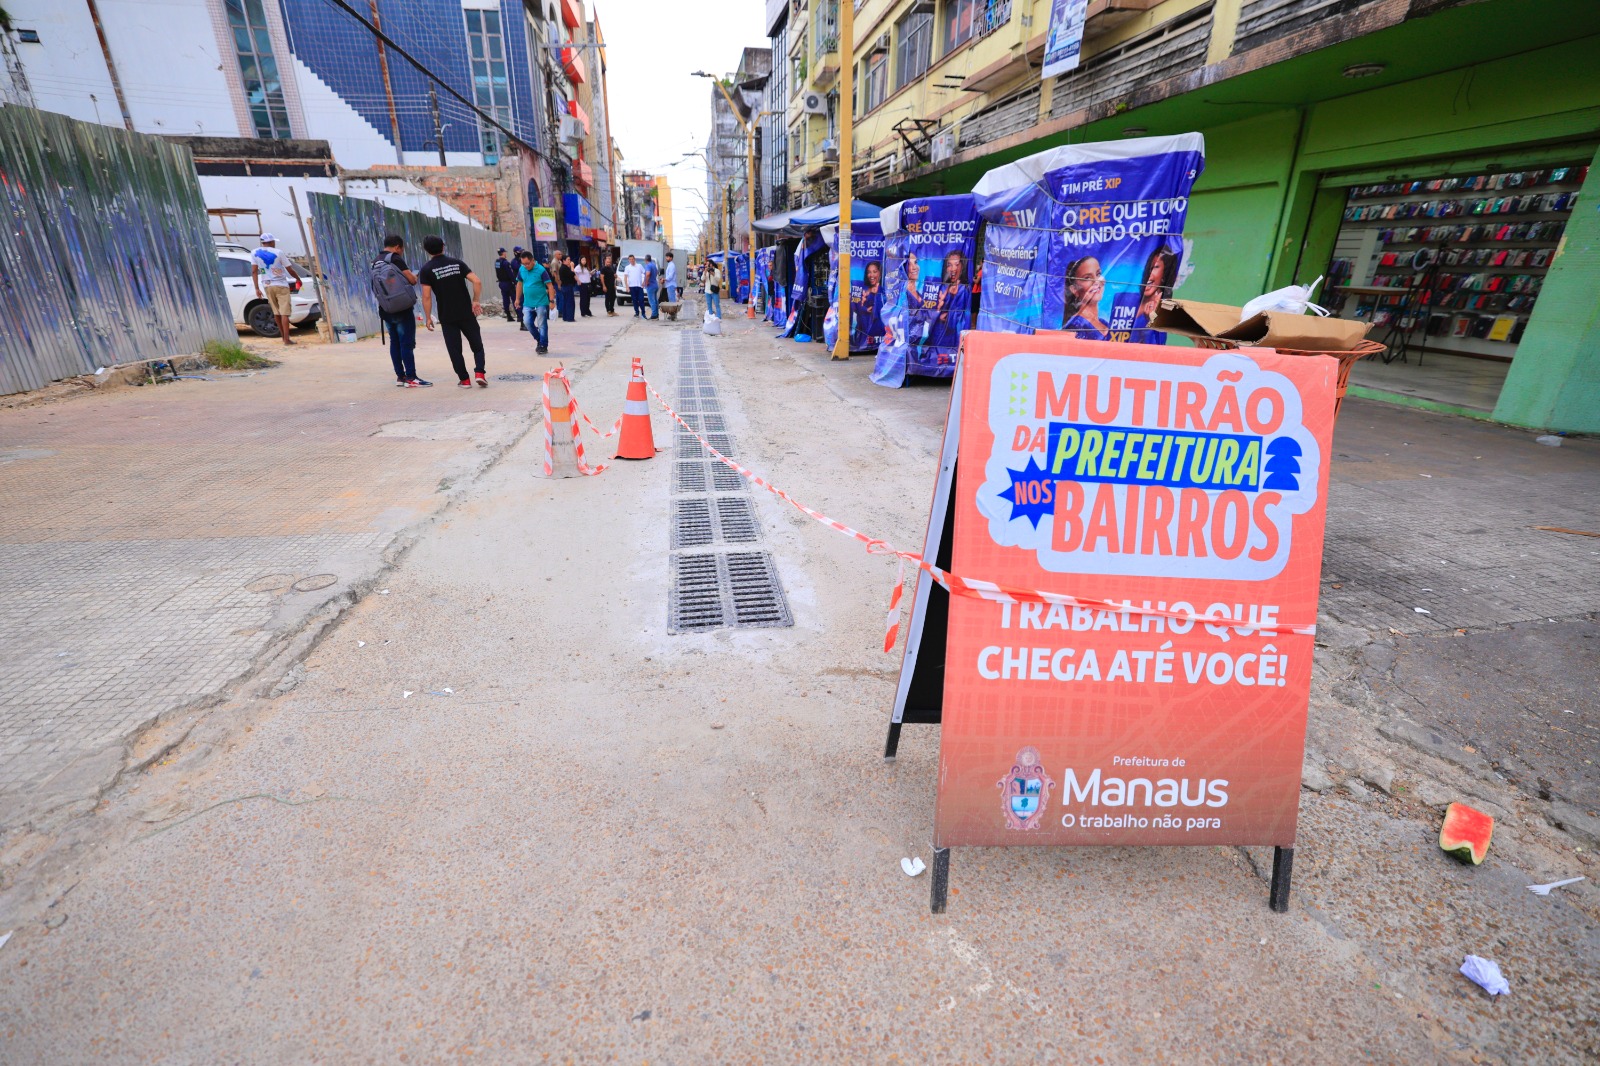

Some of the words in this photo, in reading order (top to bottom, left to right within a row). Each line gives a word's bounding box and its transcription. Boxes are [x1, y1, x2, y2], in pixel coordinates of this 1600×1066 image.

[1061, 183, 1080, 195] TIM
[1082, 176, 1102, 192] PRÉ
[1104, 177, 1122, 190] XIP
[918, 205, 929, 213] XIP
[1063, 210, 1077, 227] O
[1079, 201, 1111, 226] PRÉ
[1112, 201, 1148, 223] QUE
[906, 220, 922, 233] RÉ
[922, 221, 946, 234] QUE
[909, 233, 932, 245] NDO
[933, 232, 965, 246] QUER.
[1063, 224, 1126, 247] MUNDO
[850, 240, 865, 250] QUE
[857, 248, 880, 258] QUER.
[925, 284, 940, 293] TIM
[923, 292, 938, 301] PRÉ
[922, 300, 937, 309] XIP
[1114, 306, 1136, 318] TIM
[1110, 317, 1133, 330] PRÉ
[1109, 331, 1131, 343] XIP
[1034, 370, 1285, 435] MUTIRÃO
[1011, 425, 1046, 453] DA
[1052, 428, 1260, 486] PREFEITURA
[1014, 479, 1052, 506] NOS
[1051, 480, 1282, 562] BAIRROS
[996, 599, 1196, 635] TRABALHO
[1204, 602, 1280, 643] QUE
[977, 645, 1101, 681] CHEGA
[1106, 640, 1174, 683] ATÉ
[1182, 643, 1289, 687] VOCÊ!
[1113, 756, 1169, 767] Prefeitura
[1171, 757, 1186, 767] de
[1062, 768, 1229, 807] Manaus
[1061, 814, 1075, 828] O
[1079, 814, 1148, 828] trabalho
[1153, 814, 1182, 828] não
[1186, 815, 1221, 831] para
